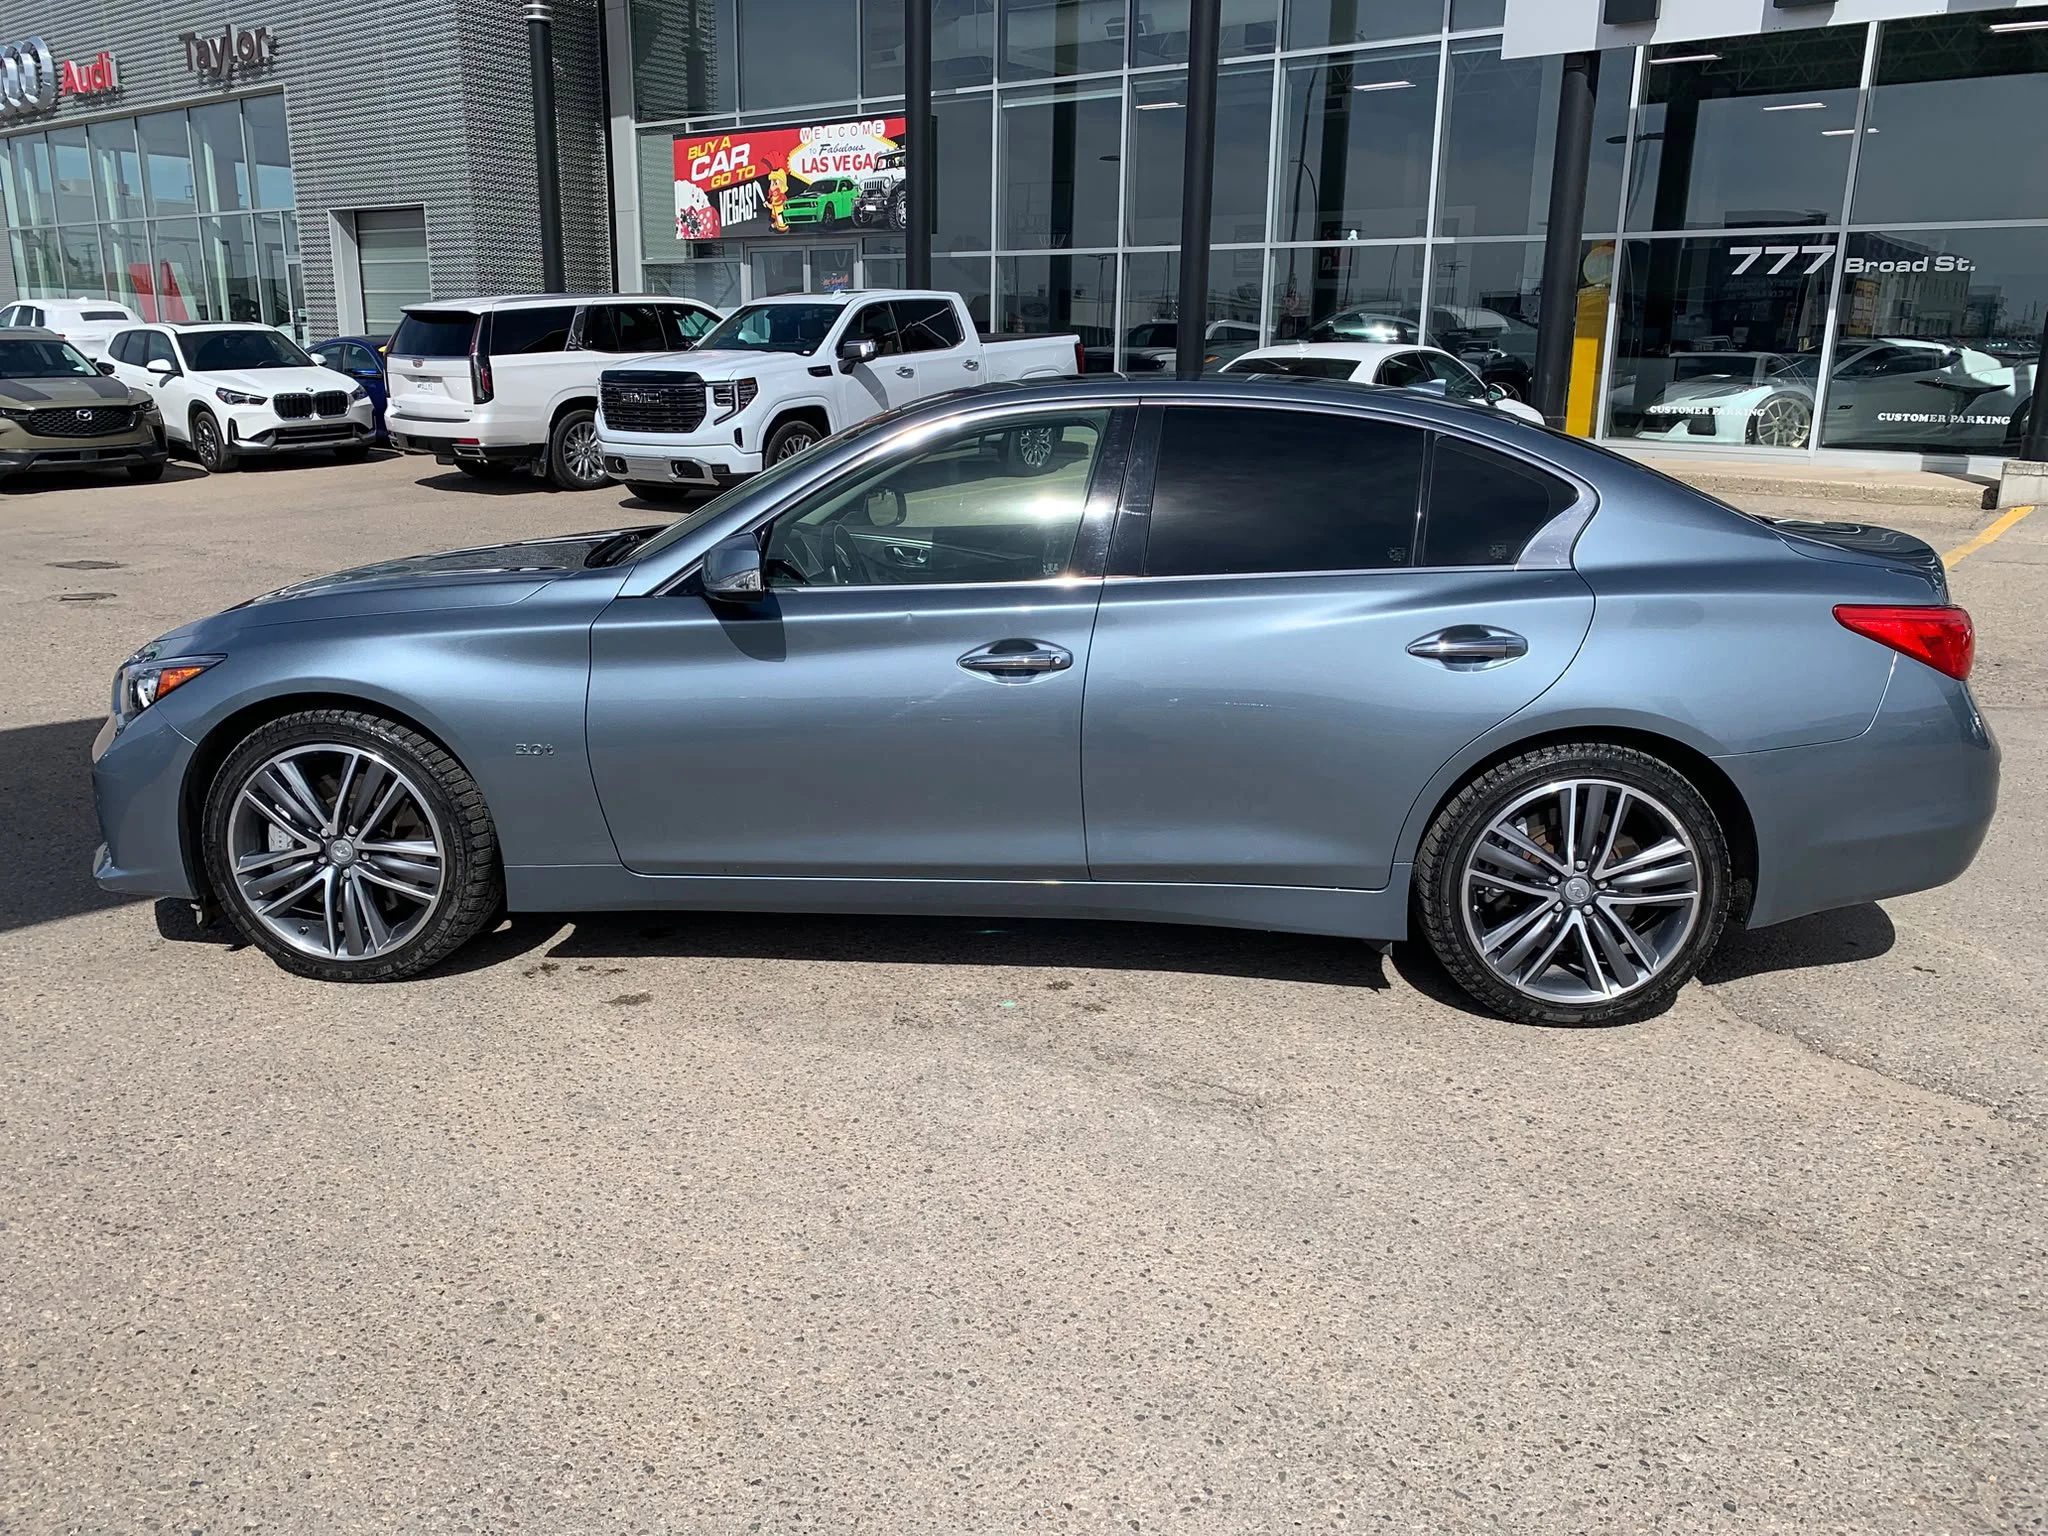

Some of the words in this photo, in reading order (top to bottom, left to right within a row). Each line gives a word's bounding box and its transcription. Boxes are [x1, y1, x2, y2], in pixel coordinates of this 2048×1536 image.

[179, 24, 272, 77] Taylor
[62, 51, 114, 95] Audi
[801, 122, 882, 140] WELCOME
[688, 139, 719, 160] BUY
[720, 135, 731, 150] A
[819, 143, 866, 156] Fabulous
[691, 143, 750, 181] CAR
[802, 157, 829, 174] LAS
[711, 172, 731, 188] GO
[736, 165, 755, 180] TO
[719, 180, 758, 227] VEGAS!
[1729, 245, 1836, 275] 777
[1845, 256, 1928, 273] Broad
[1934, 256, 1976, 272] St.
[1649, 405, 1710, 415] CUSTOMER
[1712, 406, 1766, 417] PARKING
[1877, 412, 1947, 423] CUSTOMER
[1950, 415, 2011, 425] PARKING
